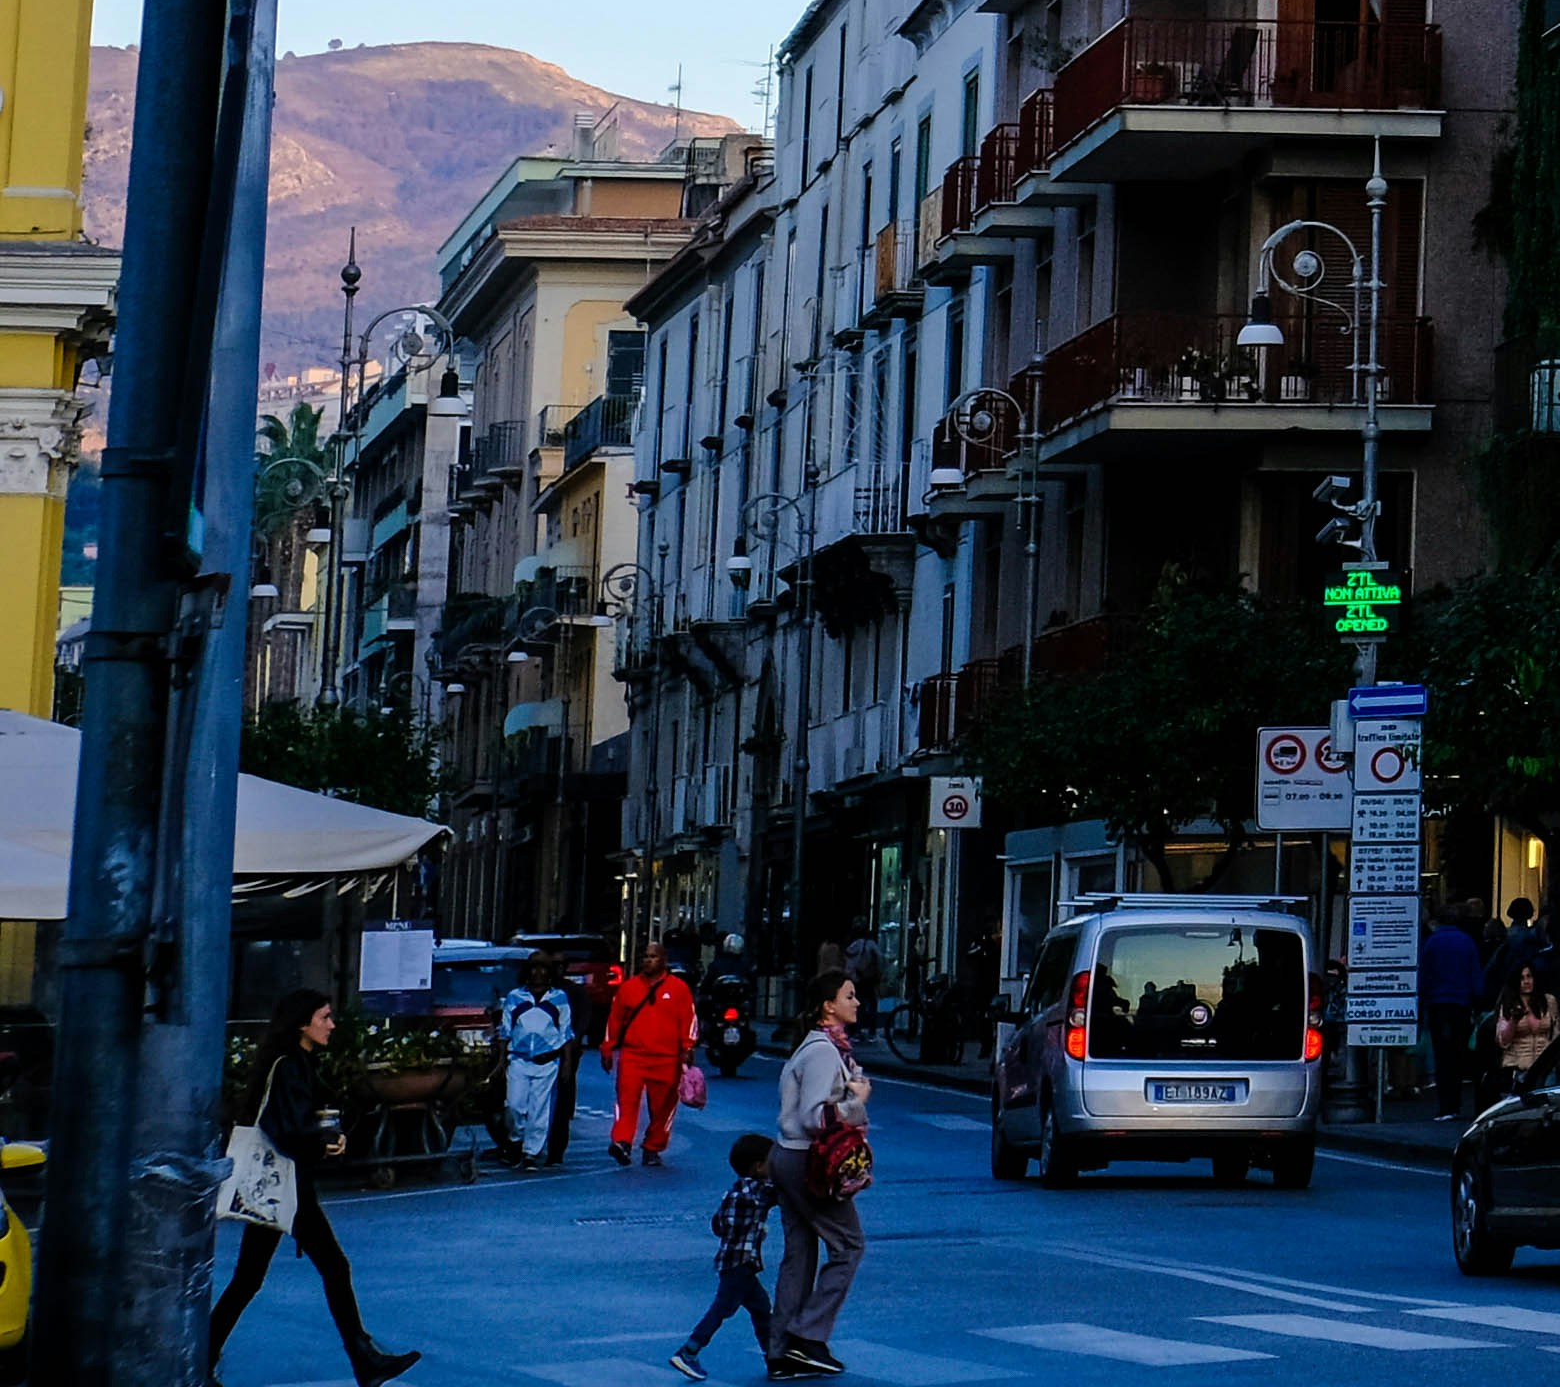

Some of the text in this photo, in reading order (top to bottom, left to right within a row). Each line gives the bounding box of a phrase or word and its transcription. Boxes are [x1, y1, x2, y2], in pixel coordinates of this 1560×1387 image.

[1346, 572, 1377, 587] ZTL
[1325, 586, 1401, 601] NON ATTIVA
[1345, 605, 1377, 618] ZTL
[1336, 618, 1388, 632] OPENED
[1347, 1010, 1415, 1018] CORSO ITALIA
